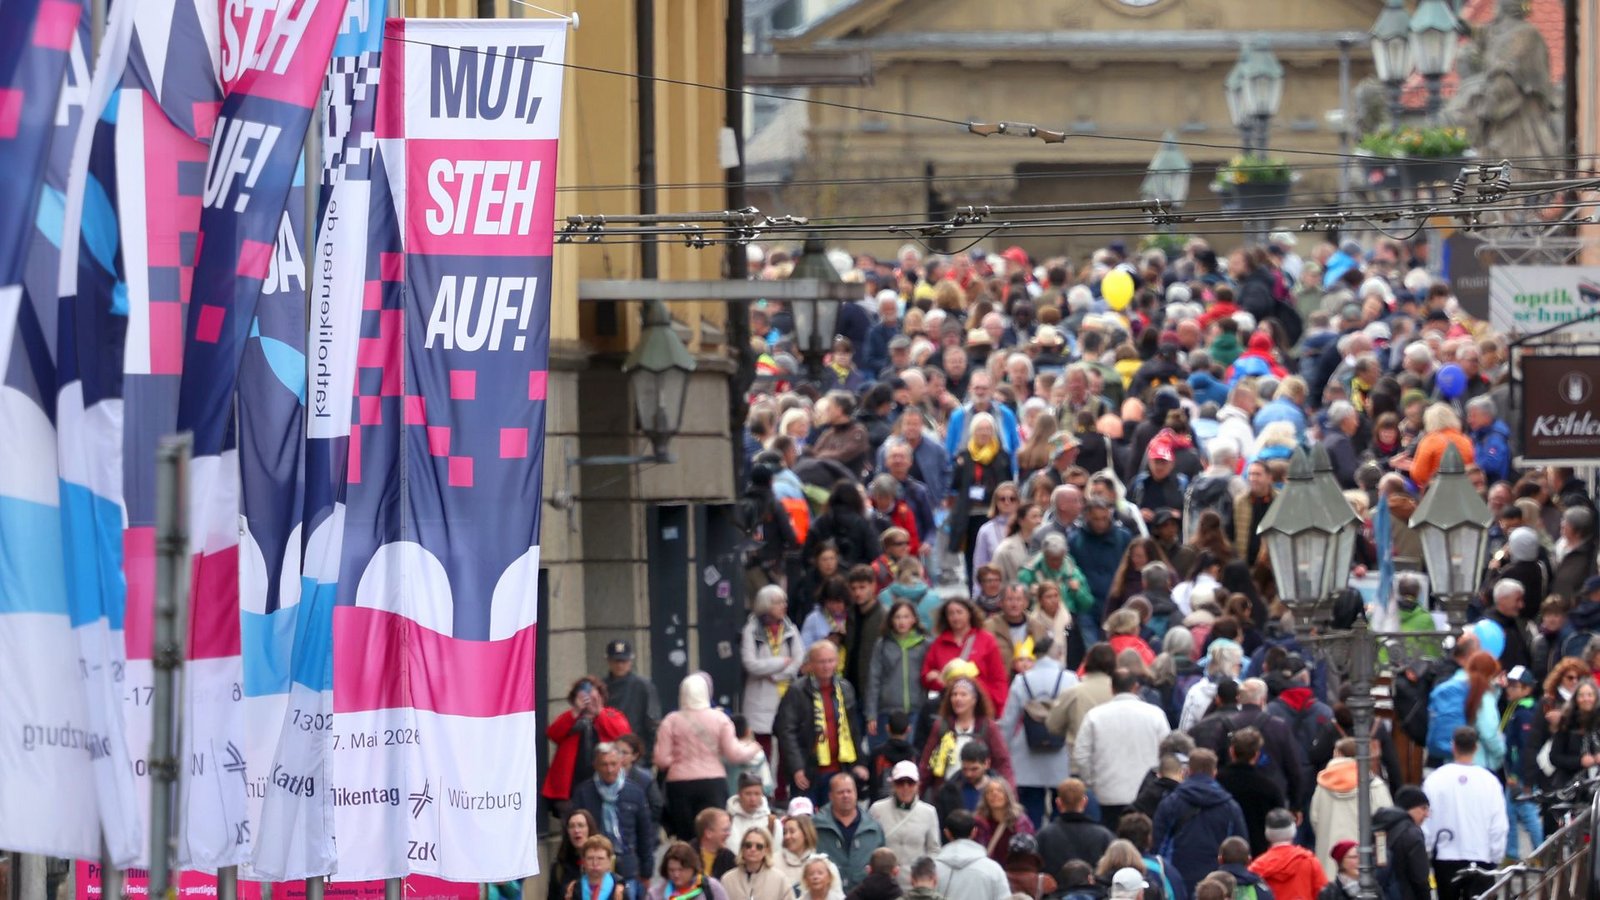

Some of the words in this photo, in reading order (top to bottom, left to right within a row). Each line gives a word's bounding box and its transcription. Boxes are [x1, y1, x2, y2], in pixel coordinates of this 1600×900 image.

[430, 45, 545, 124] MUT,
[203, 117, 282, 213] UF!
[425, 159, 541, 236] STEH
[425, 276, 537, 351] AUF!
[1514, 289, 1573, 308] optik
[350, 731, 378, 749] Mai
[384, 728, 421, 746] 2026
[448, 787, 522, 811] Würzburg
